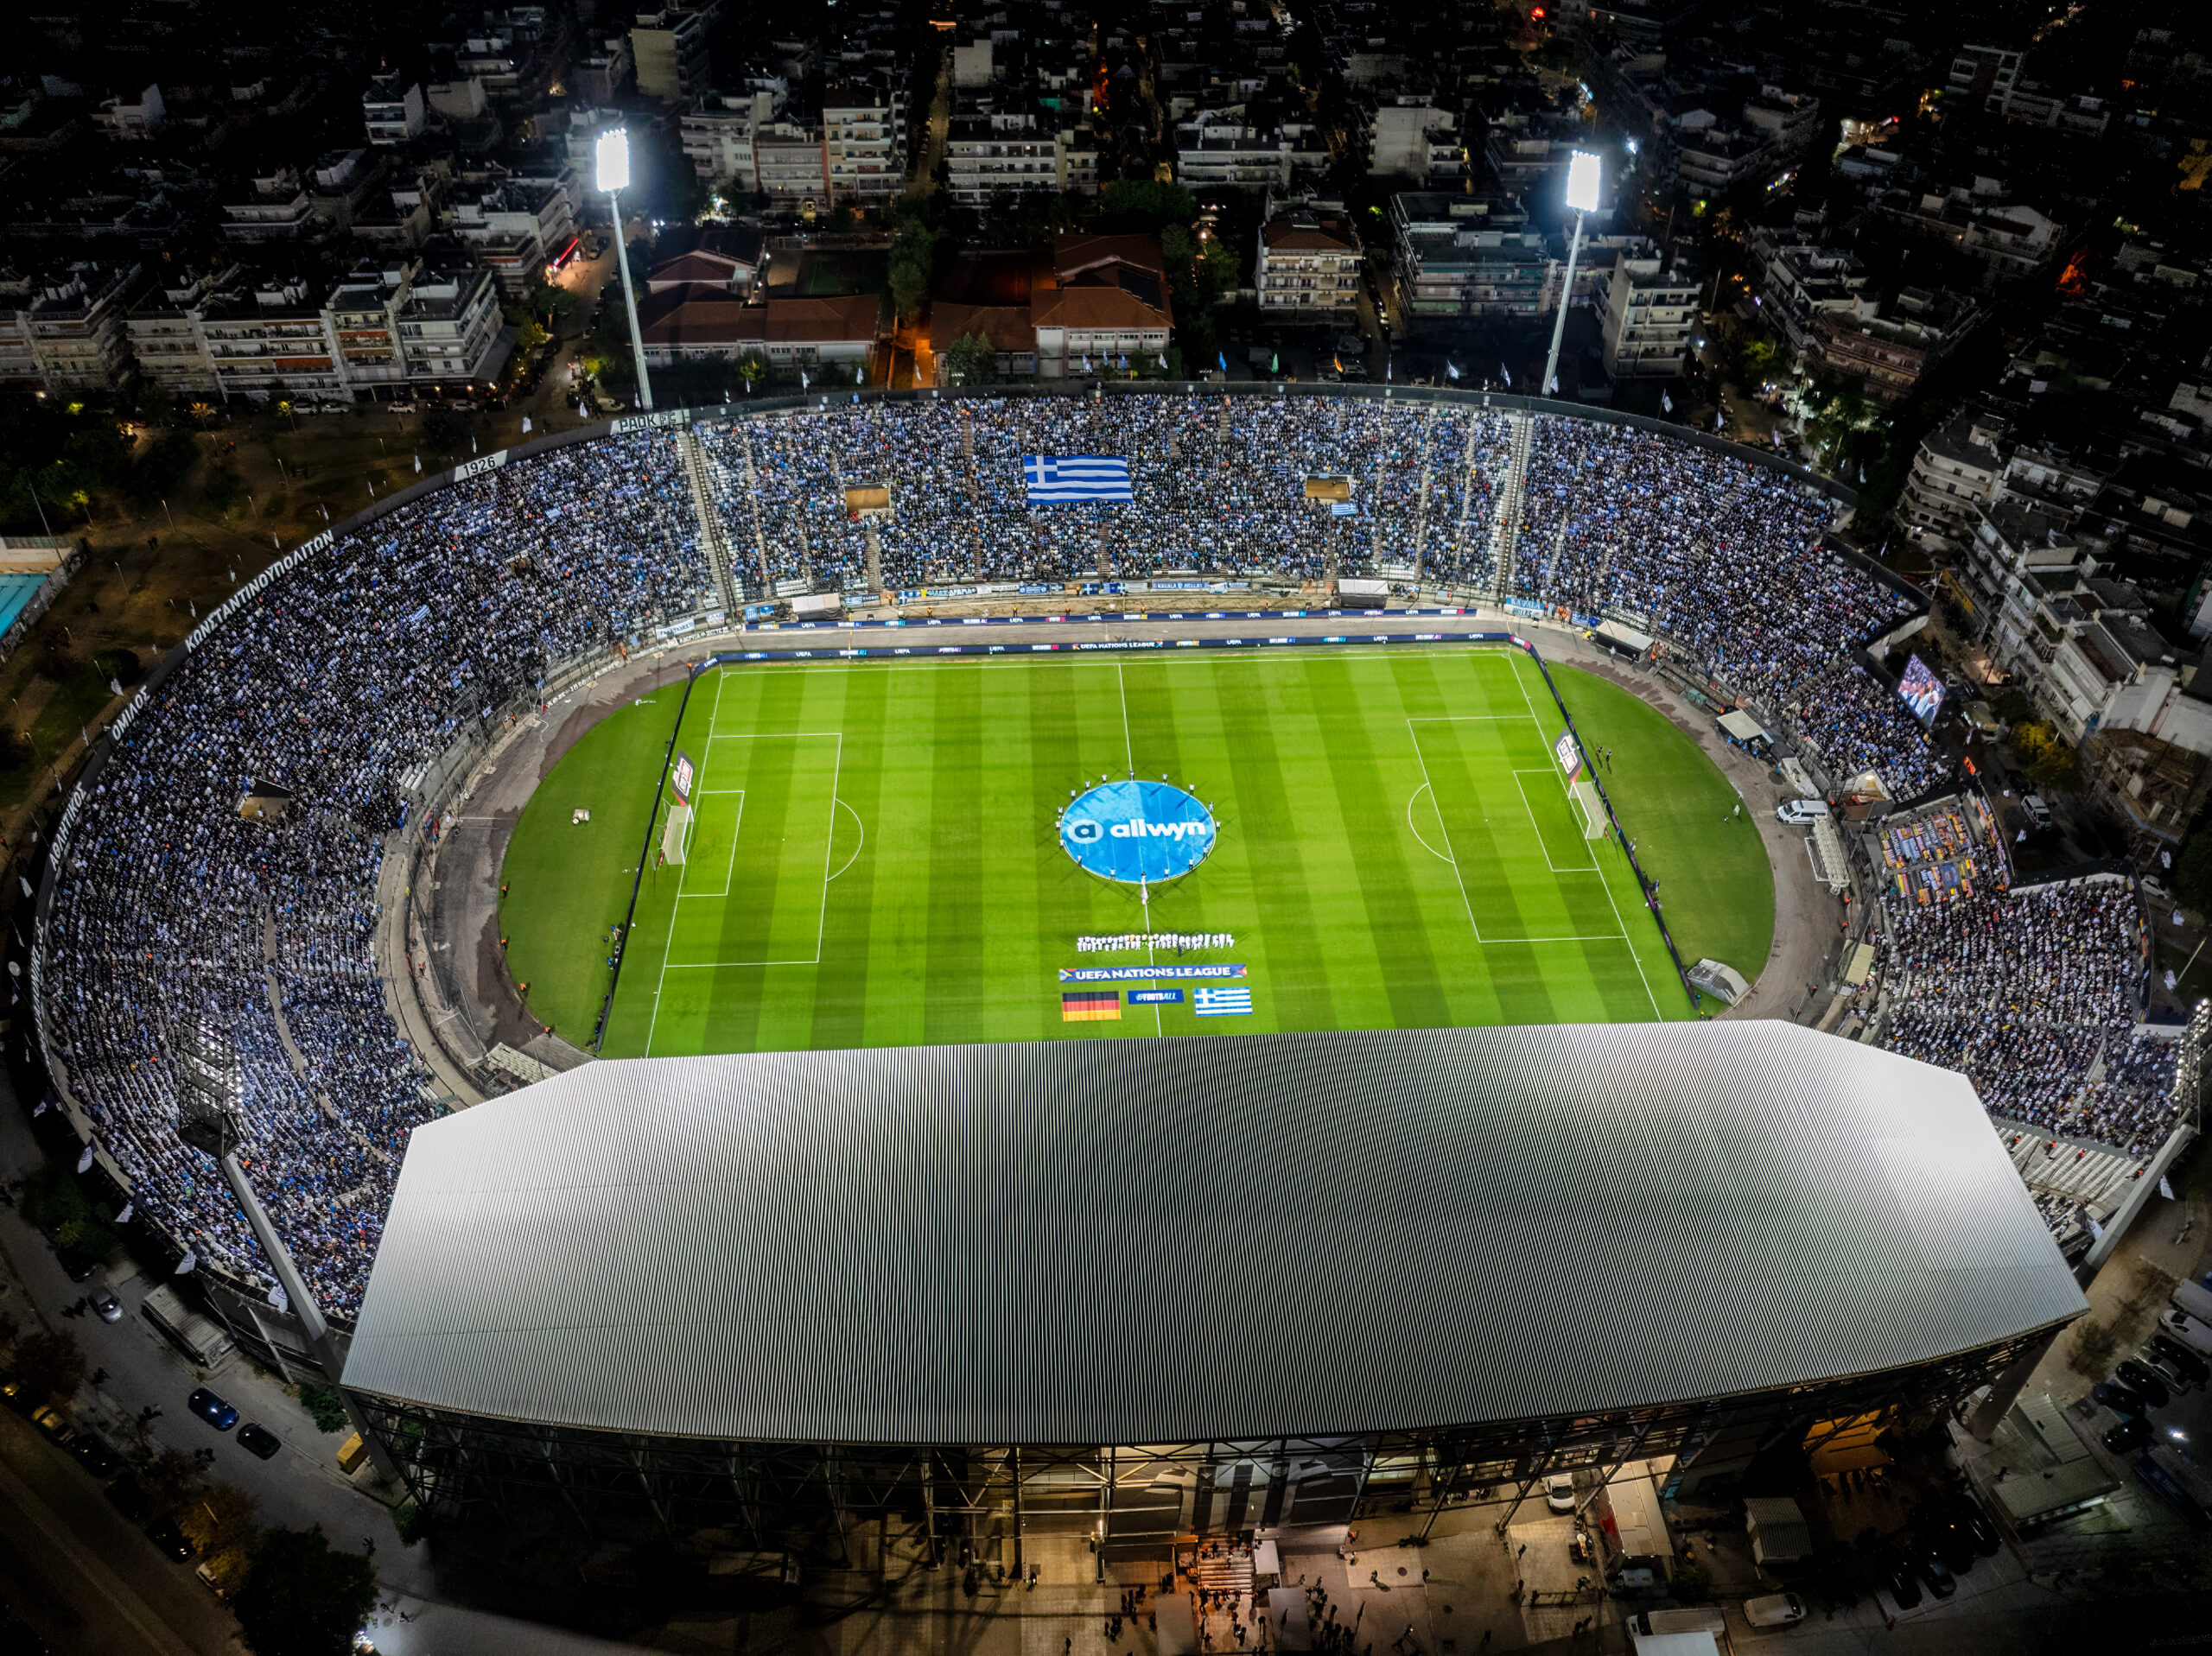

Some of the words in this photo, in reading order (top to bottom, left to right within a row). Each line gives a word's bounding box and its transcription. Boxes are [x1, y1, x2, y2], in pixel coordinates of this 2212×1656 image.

[463, 456, 495, 476] 1926
[1512, 607, 1532, 618] HELLAS
[48, 781, 87, 872] ΑΘΛΗΤΙΚΟΣ
[111, 684, 151, 740] ΟΜΙΛΟΣ
[185, 530, 334, 654] ΚΩΝΣΤΑΝΤΙΝΟΥΠΟΛΙΤΩΝ
[1110, 818, 1206, 841] allwyn
[1076, 970, 1110, 980] UEFA
[1113, 968, 1174, 979] NATIONS
[1177, 967, 1231, 977] LEAGUE
[1135, 993, 1177, 1001] #FOOTBALL
